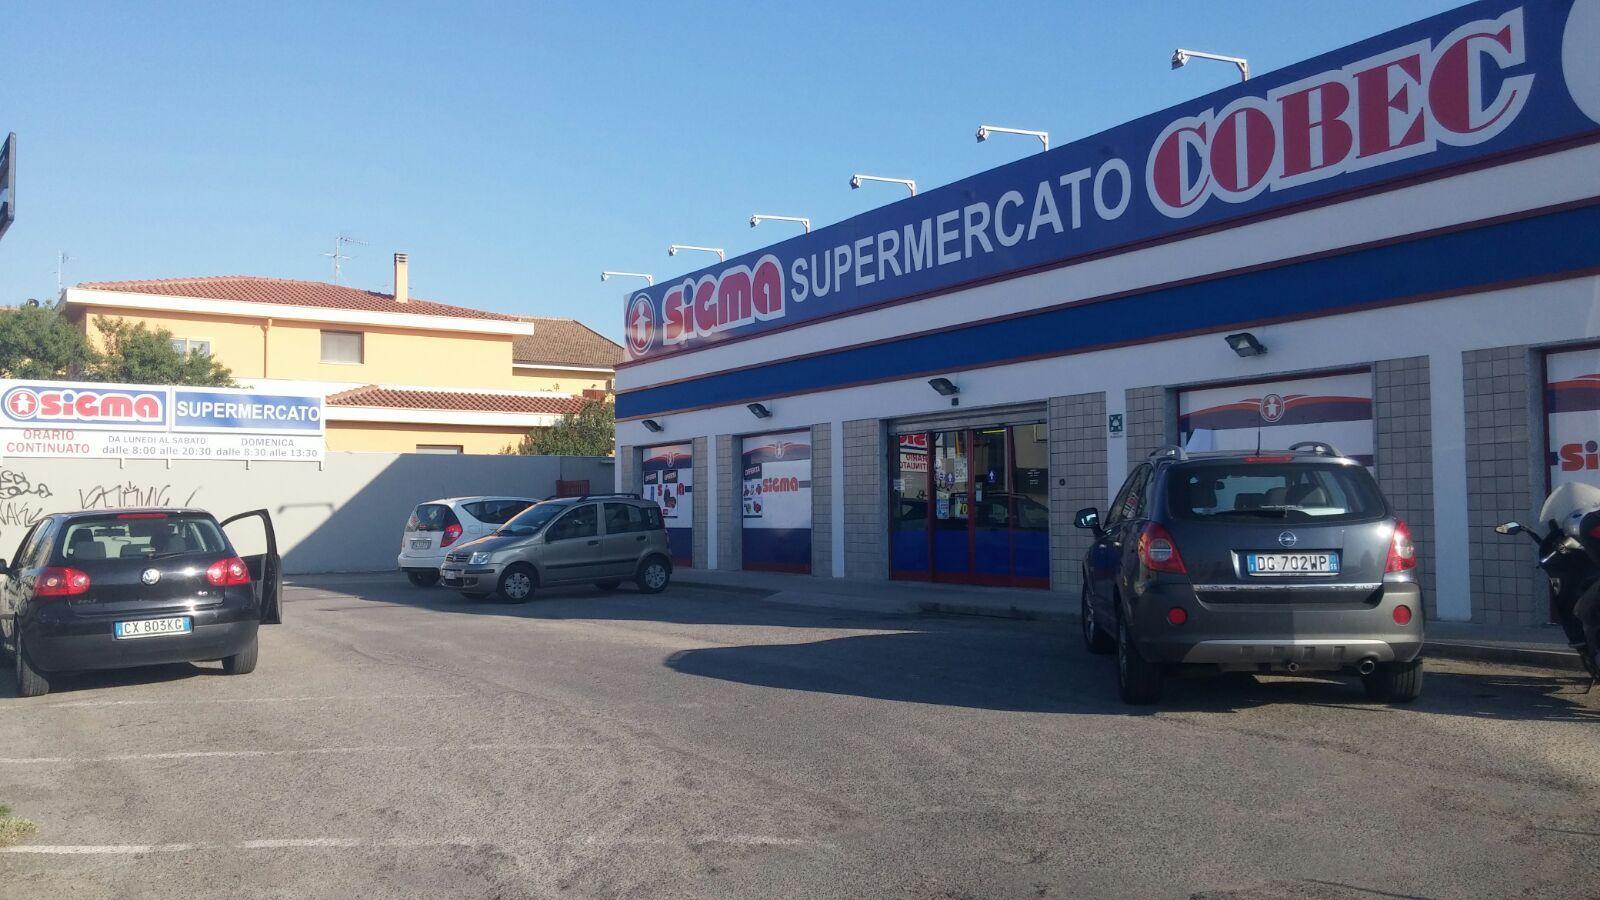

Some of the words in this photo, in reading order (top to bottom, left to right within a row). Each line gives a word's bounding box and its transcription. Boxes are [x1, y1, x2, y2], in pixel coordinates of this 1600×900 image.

[791, 158, 1131, 303] SUPERMERCATO
[1147, 8, 1535, 218] COBEC
[177, 401, 320, 421] SUPERMERCATO
[23, 429, 75, 440] ORARIO
[108, 435, 120, 443] DA
[6, 442, 90, 453] CONTINUATO
[241, 438, 294, 446] DOMENICA
[102, 446, 129, 454] dalle
[132, 447, 156, 455] 8:00
[159, 447, 179, 455] alle
[182, 447, 211, 456] 20:30
[216, 448, 240, 456] dalle
[269, 449, 287, 457] alle
[291, 450, 318, 458] 13:30
[1258, 556, 1276, 571] DG
[1281, 555, 1327, 571] 702WP
[124, 622, 139, 634] CX
[144, 619, 182, 632] 803KG
